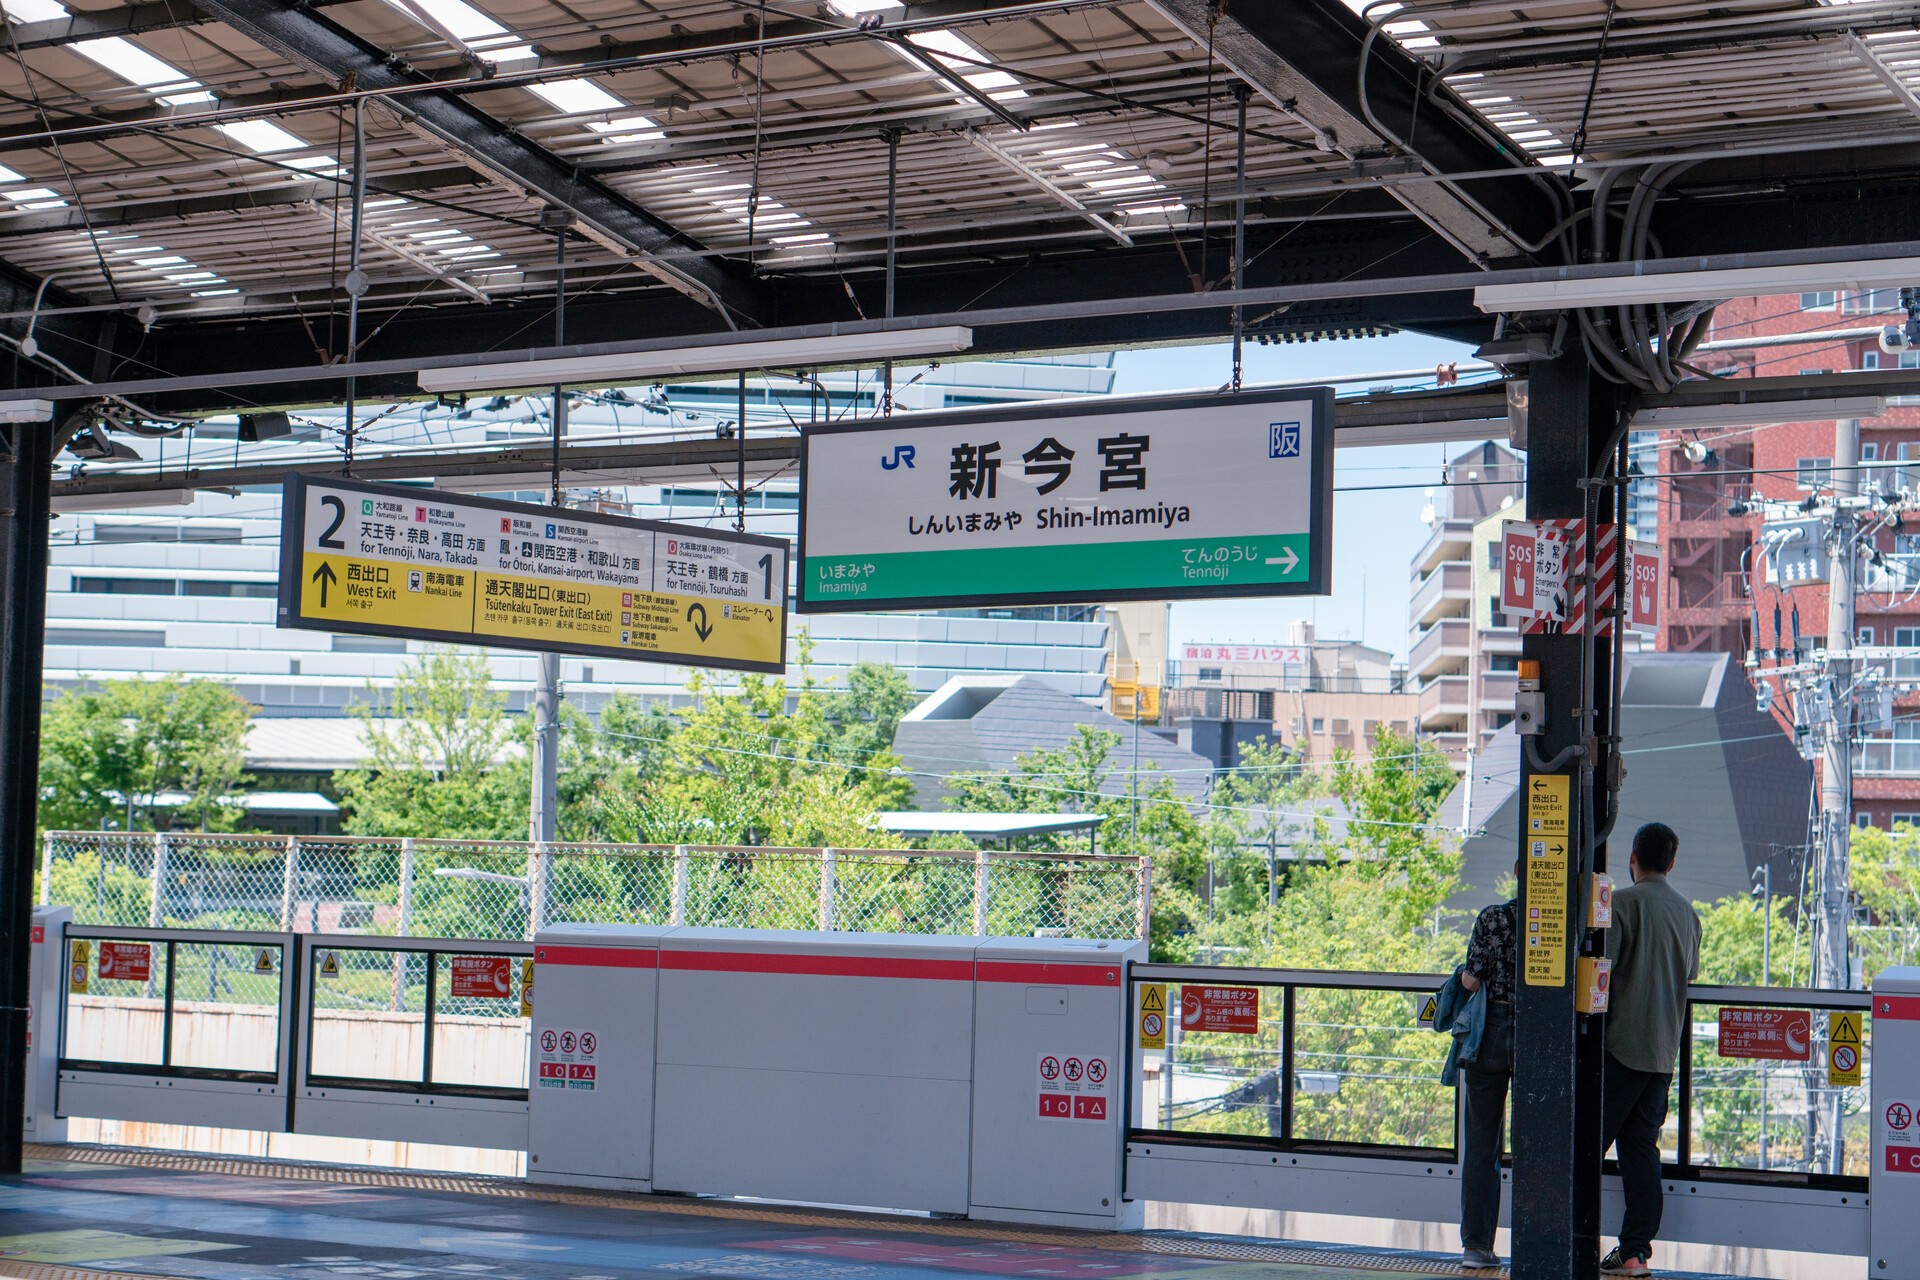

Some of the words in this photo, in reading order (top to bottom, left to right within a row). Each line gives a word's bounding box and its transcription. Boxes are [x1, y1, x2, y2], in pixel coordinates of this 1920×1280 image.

[1270, 423, 1299, 457] 阪
[881, 445, 916, 470] JR
[949, 432, 1150, 500] 新今宮
[363, 501, 373, 515] Q
[417, 508, 426, 521] T
[319, 495, 346, 550] 2
[502, 519, 510, 532] R
[908, 510, 1023, 535] しんいまみや
[1036, 501, 1191, 531] Shin-Imamiya
[546, 525, 555, 538] S
[467, 537, 486, 552] 方面
[360, 541, 376, 554] for
[378, 543, 415, 561] Tennōji,
[418, 549, 443, 563] Nara,
[445, 551, 478, 566] Takada
[1181, 544, 1259, 564] てんのうじ
[1508, 544, 1532, 563] SOS
[498, 557, 511, 569] for
[538, 562, 596, 580] Kansai-airport,
[597, 570, 639, 585] Wakayama
[622, 557, 641, 571] 方面
[818, 562, 876, 579] いまみや
[1181, 562, 1230, 580] Tennōji
[1536, 560, 1560, 576] ボタン
[347, 563, 389, 584] 西出口
[425, 571, 465, 587] 南海電車
[731, 571, 749, 584] 方面
[757, 553, 773, 600] 1
[1636, 564, 1656, 583] SOS
[666, 578, 678, 589] for
[680, 580, 709, 595] Tennōji,
[709, 583, 748, 598] Tsuruhashi
[818, 579, 868, 595] Imamiya
[1535, 577, 1559, 590] Emergency
[347, 584, 374, 598] West
[376, 587, 397, 601] Exit
[425, 586, 447, 596] Nankai
[449, 588, 463, 598] Line
[1535, 587, 1551, 598] Button
[533, 602, 558, 617] Tower
[559, 607, 574, 619] Exit
[575, 608, 597, 621] (East
[598, 610, 613, 623] Exit)
[1545, 619, 1559, 634] 17
[1532, 794, 1558, 803] 西出口
[1529, 950, 1551, 958] 新世界
[1721, 1011, 1783, 1024] 非常開ボタン
